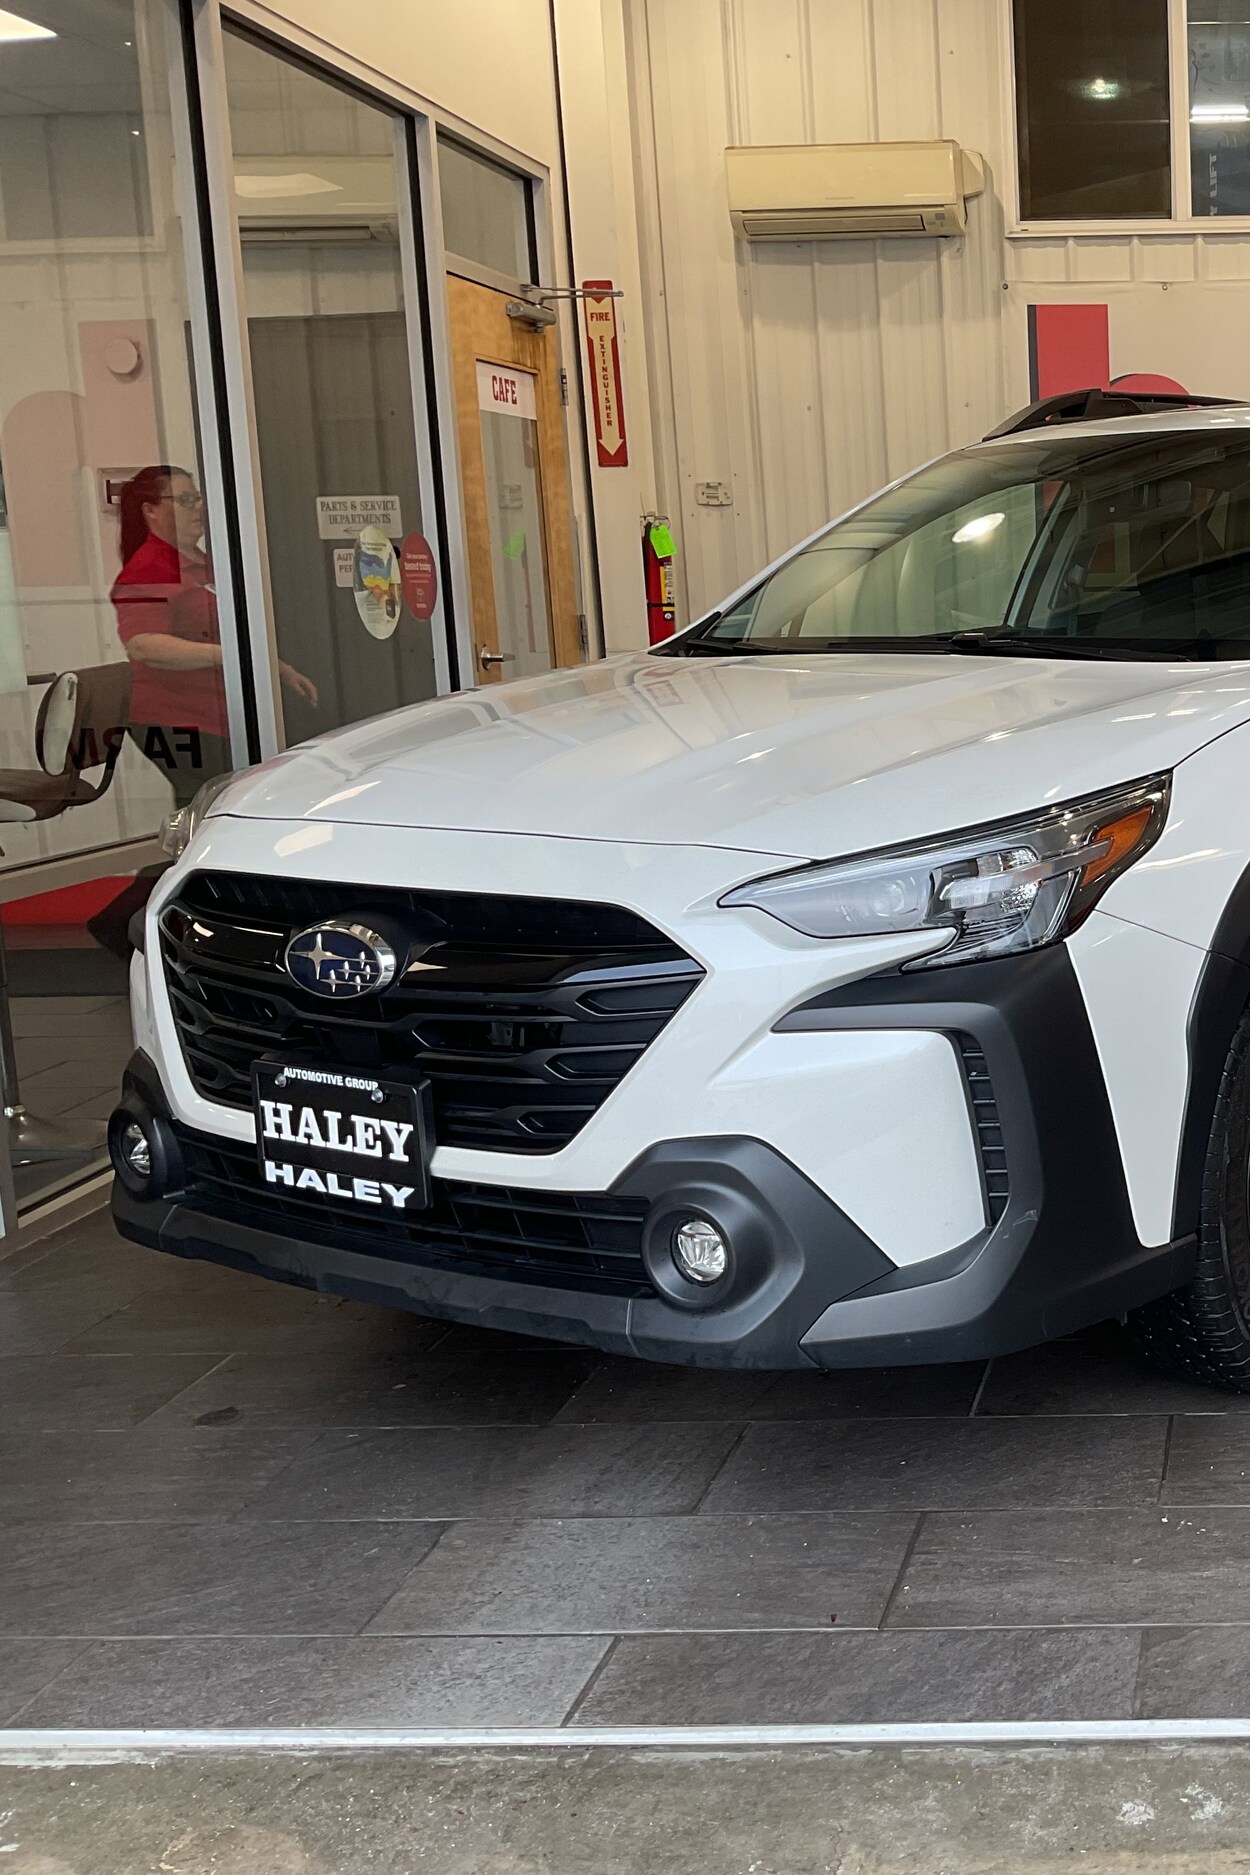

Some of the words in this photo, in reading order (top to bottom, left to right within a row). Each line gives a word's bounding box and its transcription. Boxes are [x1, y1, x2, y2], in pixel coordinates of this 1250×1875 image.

[1209, 153, 1218, 199] LIFT
[590, 311, 611, 322] FIRE
[491, 375, 518, 405] CAFE
[599, 335, 613, 426] EXTINGUISHER
[320, 501, 348, 512] PARTS
[350, 501, 358, 511] &
[360, 500, 397, 511] SERVICE
[328, 513, 392, 525] DEPARTMENTS
[283, 1066, 344, 1086] AUTOMOTIVE
[344, 1078, 379, 1091] GROUP
[260, 1100, 414, 1162] HALEY
[264, 1160, 415, 1208] HALEY
